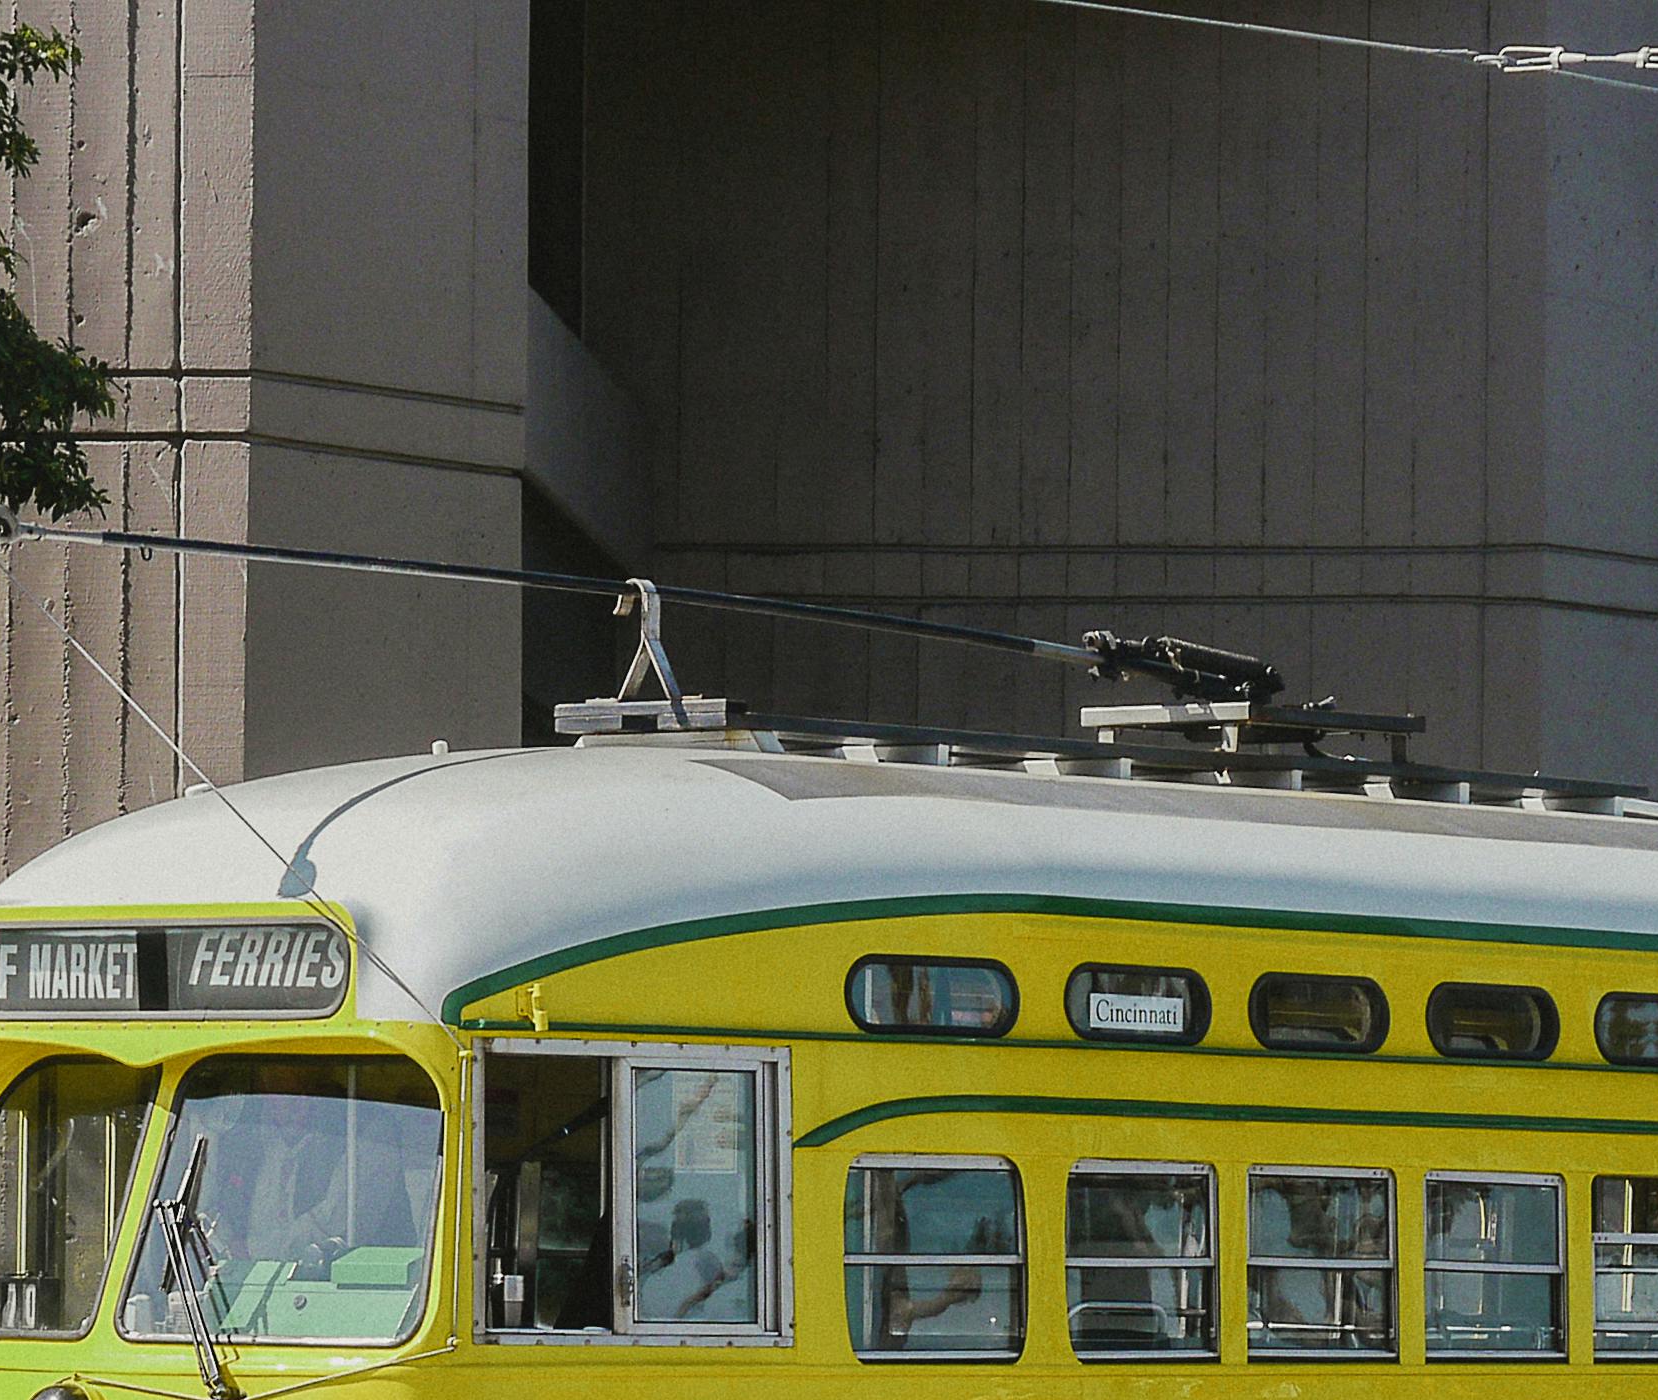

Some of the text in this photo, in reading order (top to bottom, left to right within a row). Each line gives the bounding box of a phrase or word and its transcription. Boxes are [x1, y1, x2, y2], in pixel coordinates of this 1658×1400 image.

[29, 943, 137, 1000] MARKET
[189, 928, 345, 987] FERRIES
[1096, 999, 1177, 1025] Cincinnati
